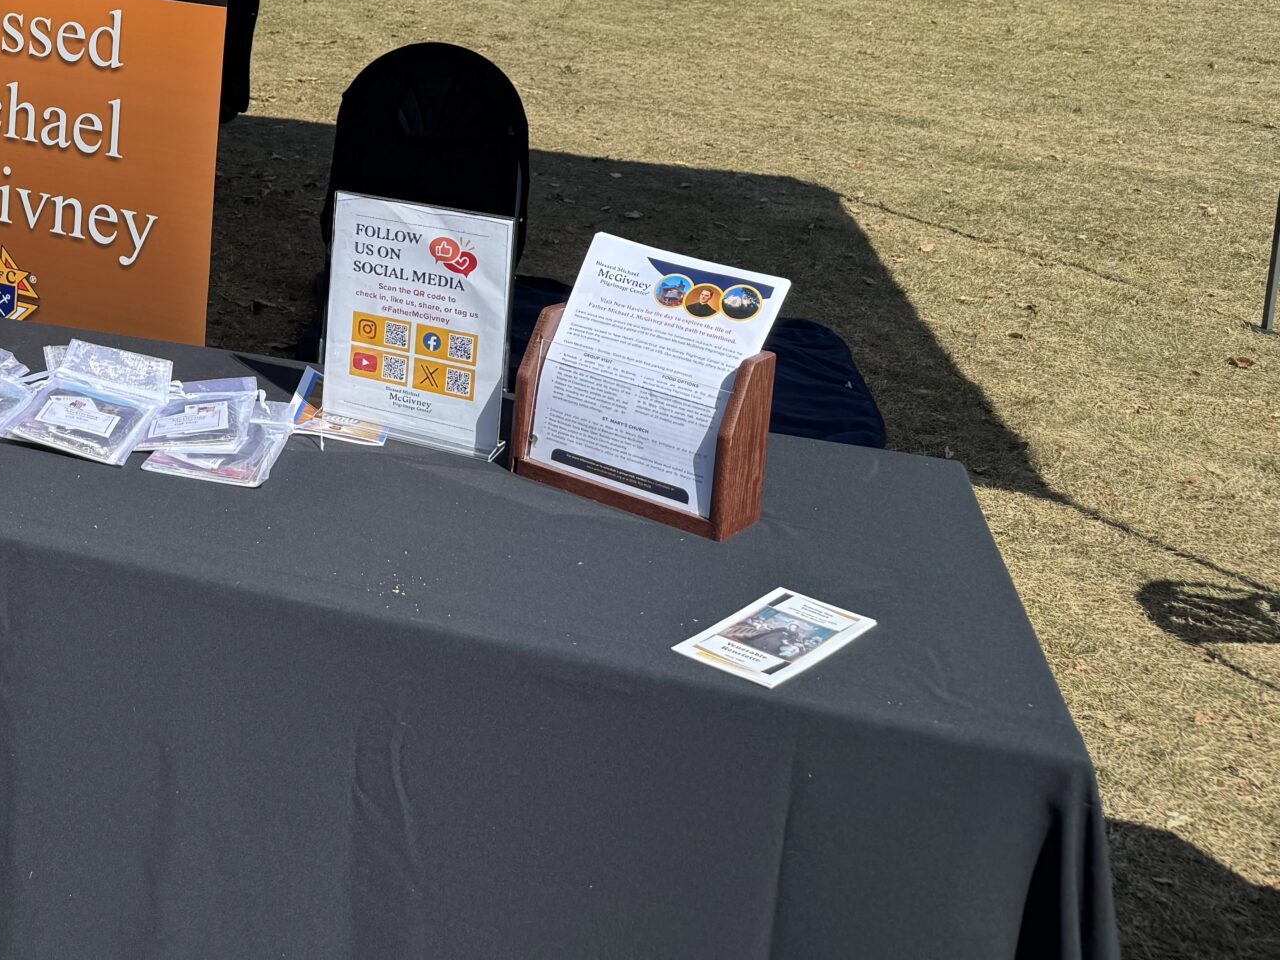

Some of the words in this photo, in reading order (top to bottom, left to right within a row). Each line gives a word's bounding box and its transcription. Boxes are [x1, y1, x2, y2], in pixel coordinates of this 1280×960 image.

[356, 224, 422, 244] FOLLOW
[354, 242, 374, 256] US
[377, 246, 402, 260] ON
[6, 270, 16, 284] C
[353, 260, 409, 281] SOCIAL
[412, 270, 464, 291] MEDIA
[598, 268, 651, 291] McGivney
[617, 266, 639, 277] Michael
[379, 283, 396, 292] Scan
[399, 285, 411, 295] the
[414, 289, 425, 297] QR
[427, 291, 446, 301] code
[600, 279, 628, 292] Pilgrimage
[630, 287, 650, 296] Center
[355, 289, 377, 299] check
[380, 294, 388, 302] in,
[390, 296, 403, 304] like
[418, 301, 442, 312] share,
[454, 309, 468, 318] tag
[600, 297, 612, 305] Visit
[627, 304, 644, 313] Haven
[682, 318, 702, 327] explore
[382, 305, 450, 325] @FatherMcGivney
[588, 301, 606, 311] Father
[608, 307, 630, 318] Michael
[636, 315, 664, 325] McGivney
[677, 379, 699, 388] OPTIONS
[389, 393, 432, 409] McGivney
[393, 402, 415, 410] Pilgrimage
[629, 424, 649, 434] CHURCH
[727, 642, 767, 659] Venerable
